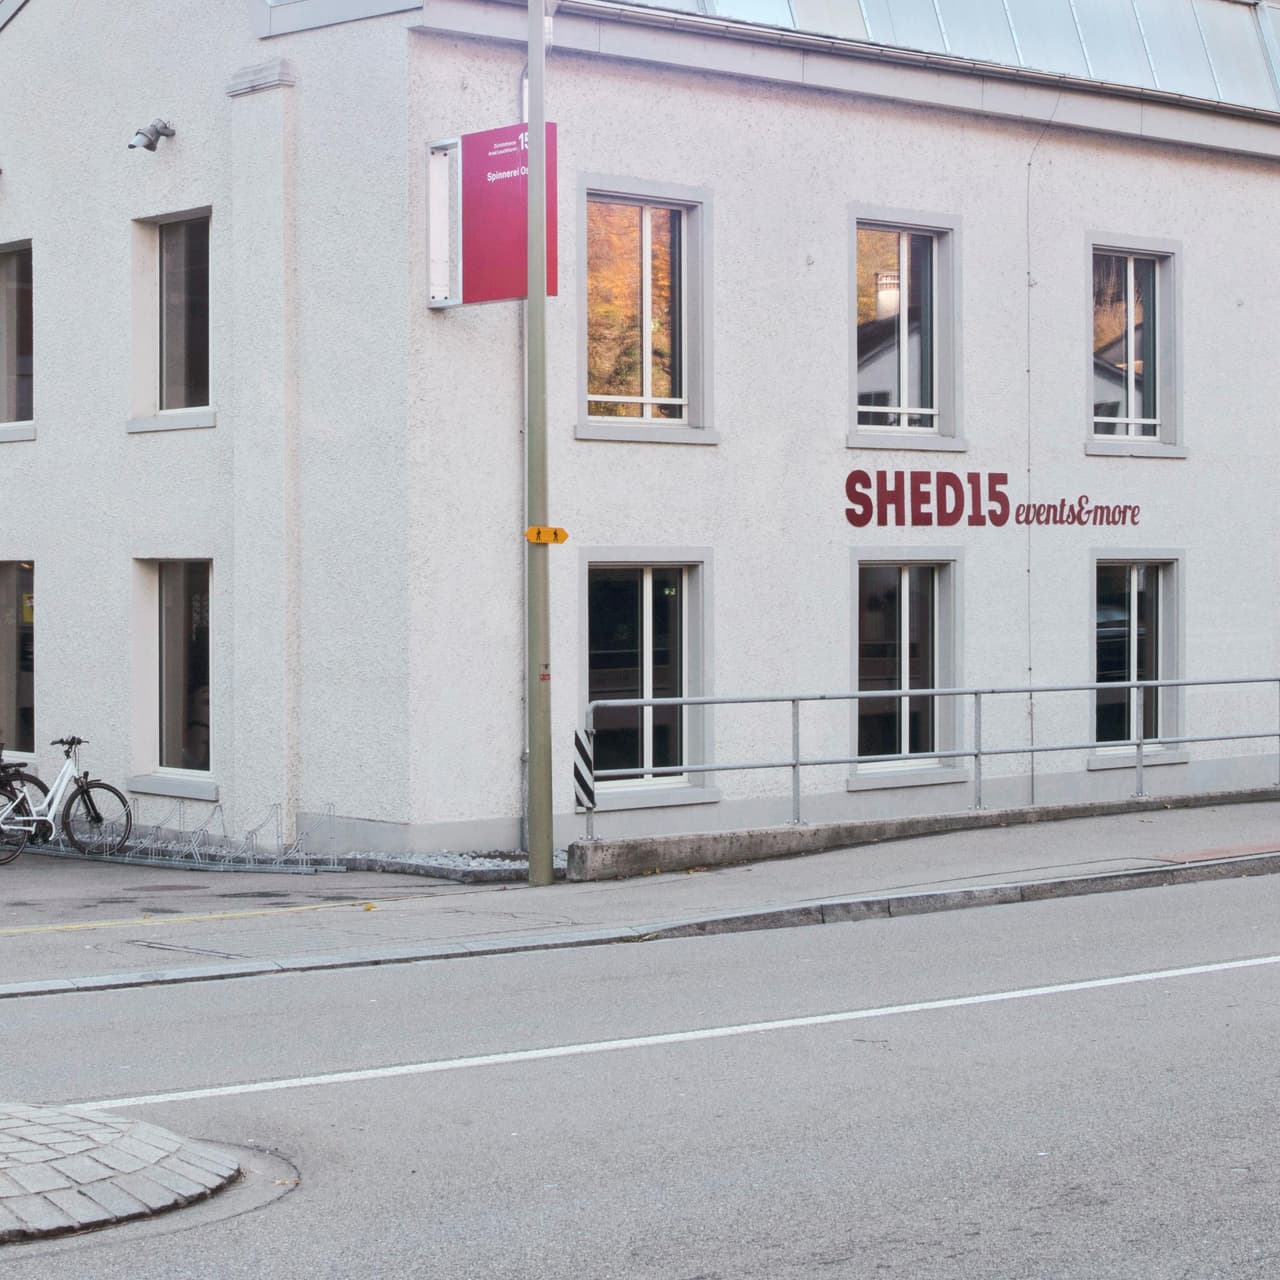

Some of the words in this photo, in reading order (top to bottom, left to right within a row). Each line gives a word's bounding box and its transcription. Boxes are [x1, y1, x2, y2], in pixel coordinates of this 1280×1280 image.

[487, 168, 520, 183] Spinnerei
[845, 469, 1010, 528] SHED15
[1015, 495, 1141, 526] events&more
